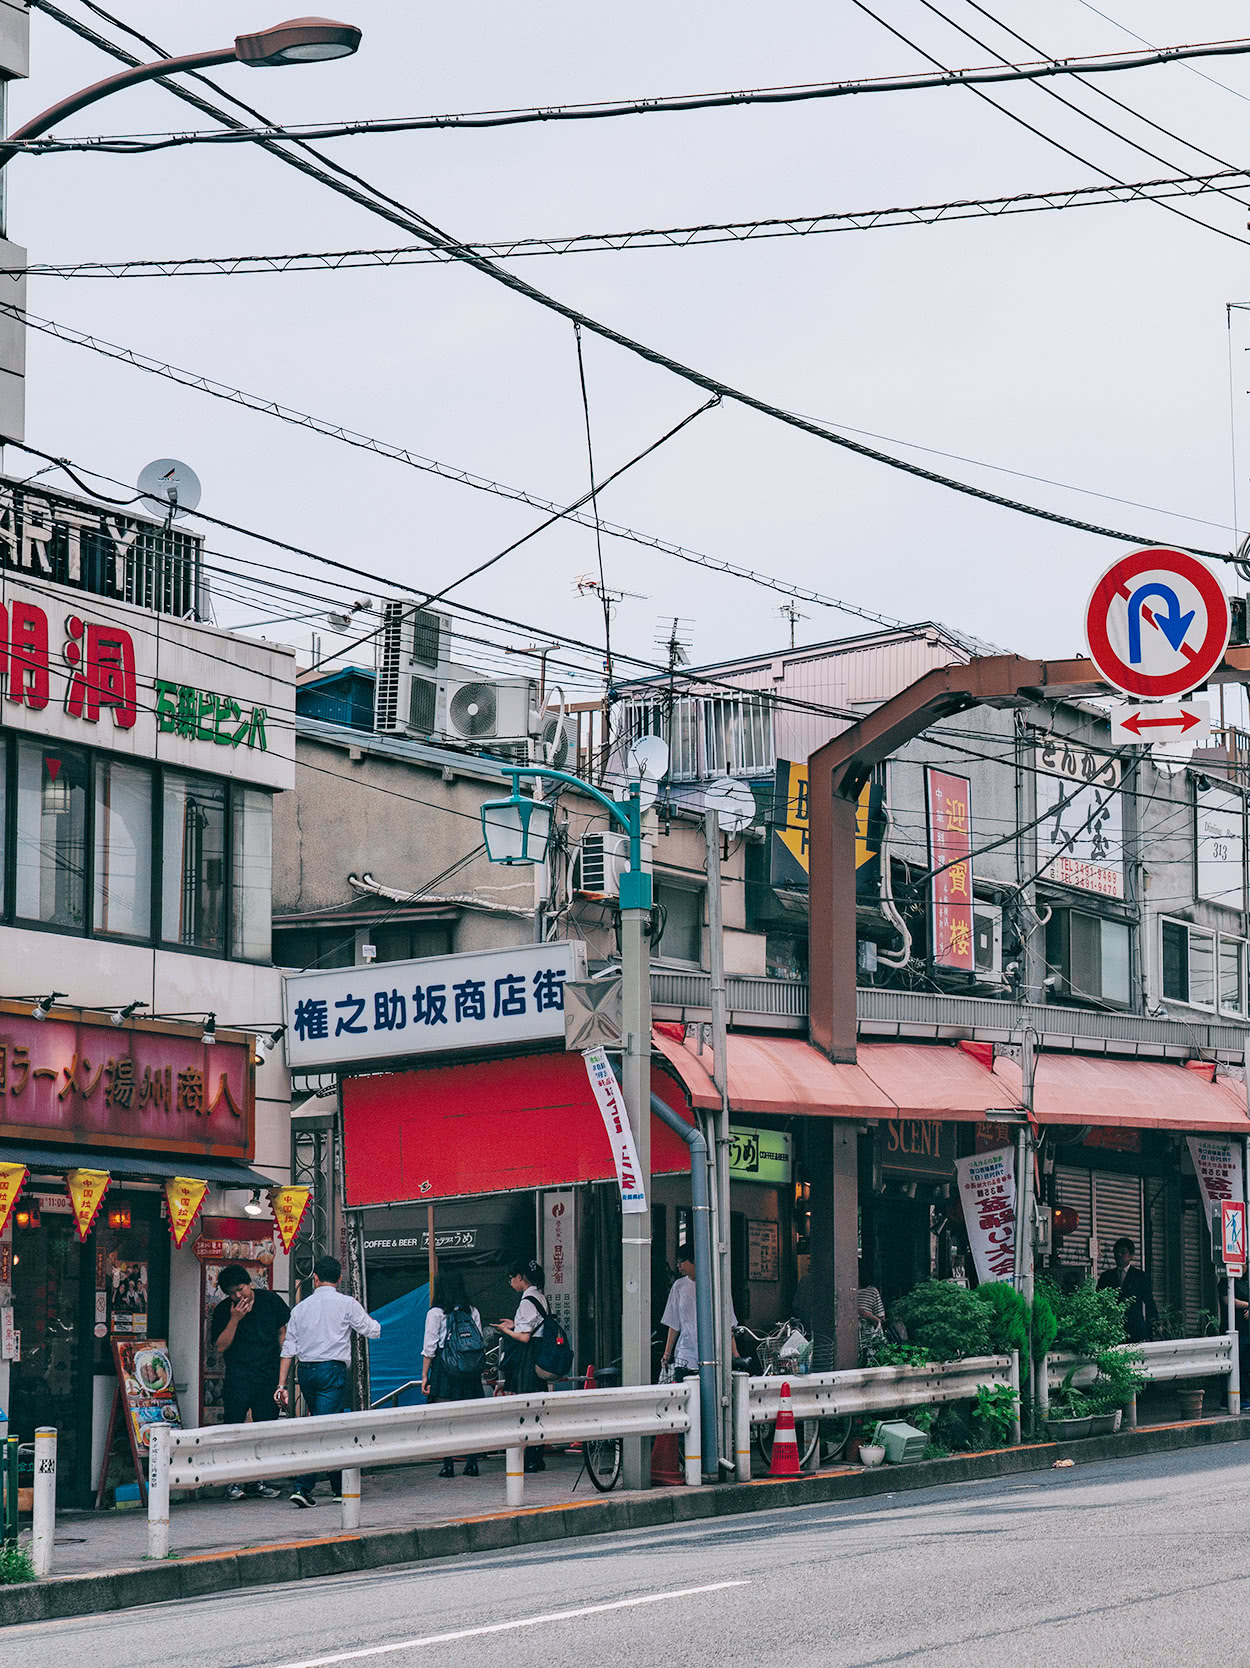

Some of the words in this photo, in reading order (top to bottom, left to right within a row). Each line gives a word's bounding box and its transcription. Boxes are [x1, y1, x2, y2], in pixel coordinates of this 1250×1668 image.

[0, 600, 136, 730] 明洞
[1213, 842, 1228, 860] 313
[1061, 858, 1073, 872] TEL
[1061, 873, 1073, 884] TEL
[294, 969, 566, 1042] 権之助坂商店街
[888, 1119, 942, 1157] SCENT
[364, 1239, 391, 1249] COFFEE
[398, 1239, 418, 1247] BEER
